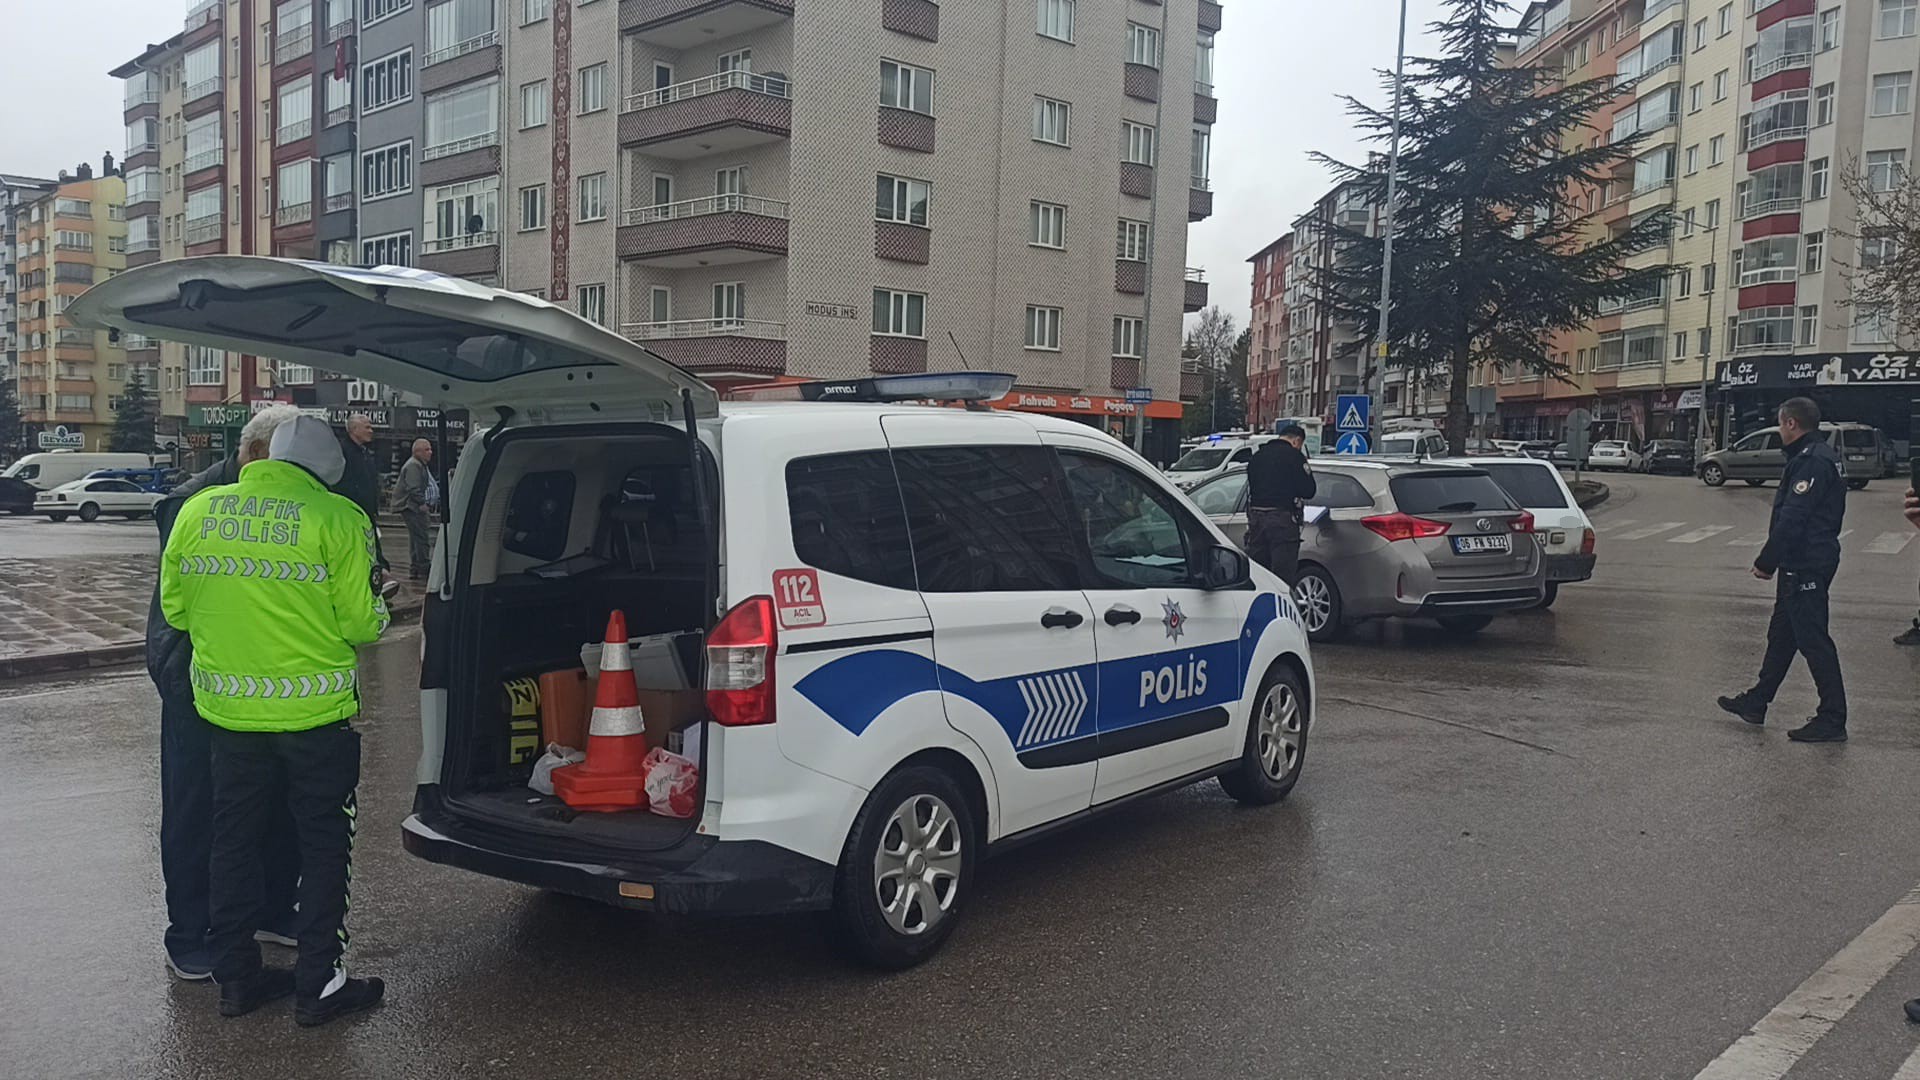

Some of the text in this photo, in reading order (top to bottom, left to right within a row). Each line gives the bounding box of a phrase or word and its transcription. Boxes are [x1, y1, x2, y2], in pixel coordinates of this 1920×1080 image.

[1869, 353, 1910, 368] ÖZ
[1851, 368, 1906, 380] YAPI
[780, 575, 815, 603] 112
[1139, 653, 1208, 708] POLİS
